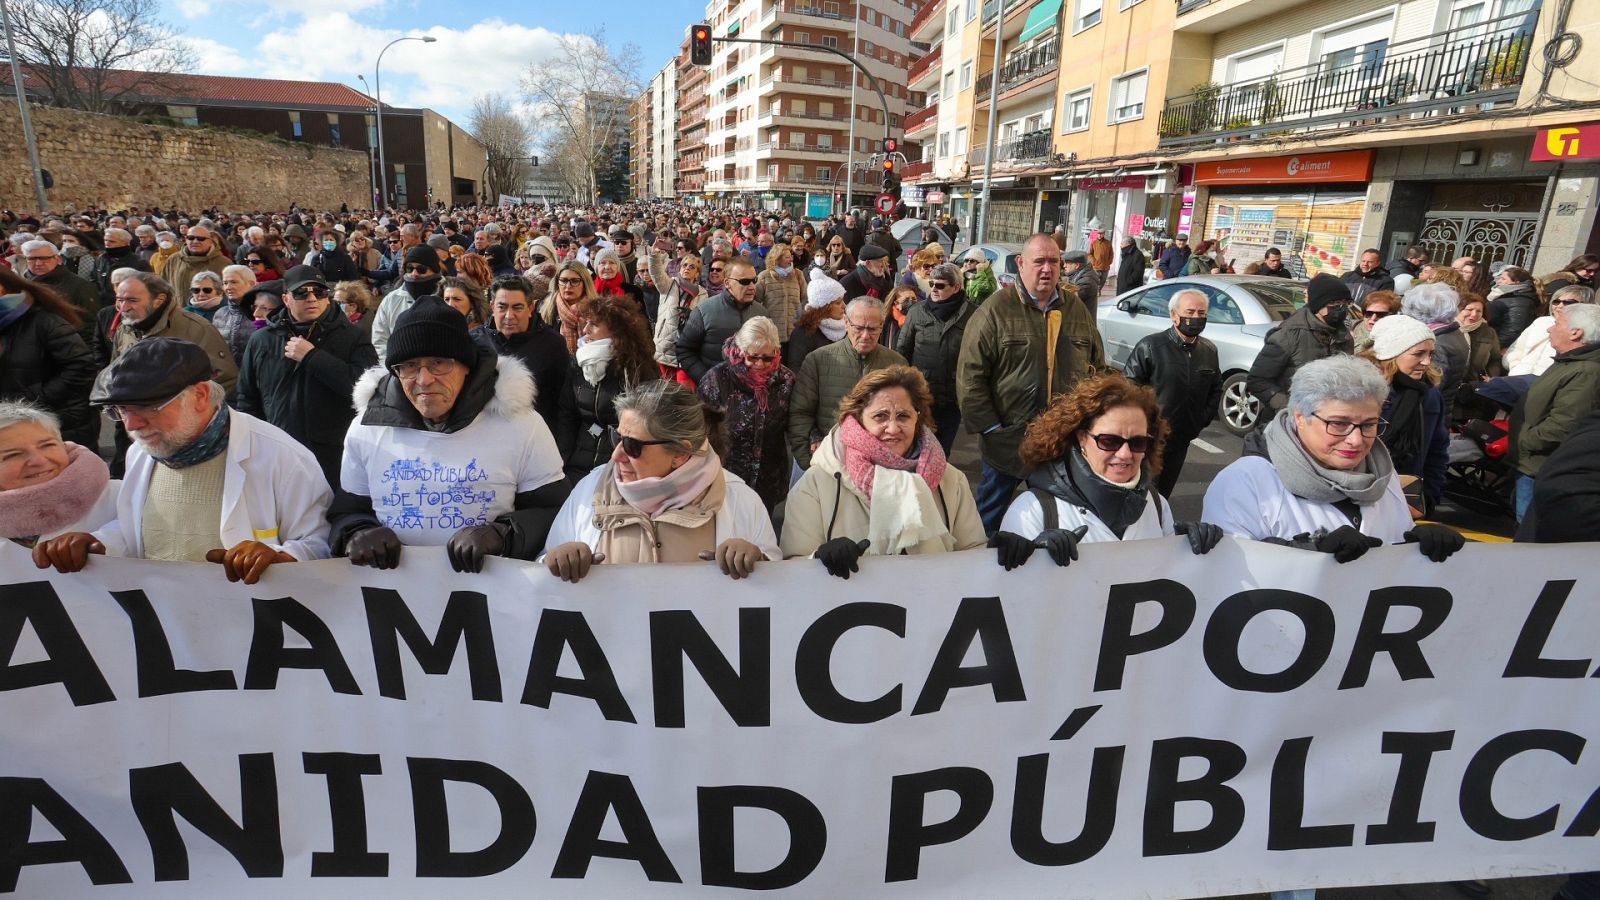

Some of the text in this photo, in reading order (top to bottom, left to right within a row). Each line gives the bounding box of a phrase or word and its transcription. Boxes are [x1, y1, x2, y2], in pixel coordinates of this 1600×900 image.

[1145, 216, 1167, 228] Outlet
[381, 468, 433, 484] SANIDAD
[391, 493, 413, 507] DE
[386, 514, 488, 530] PARA TOD@S
[1094, 578, 1453, 692] POR
[1502, 579, 1600, 680] L
